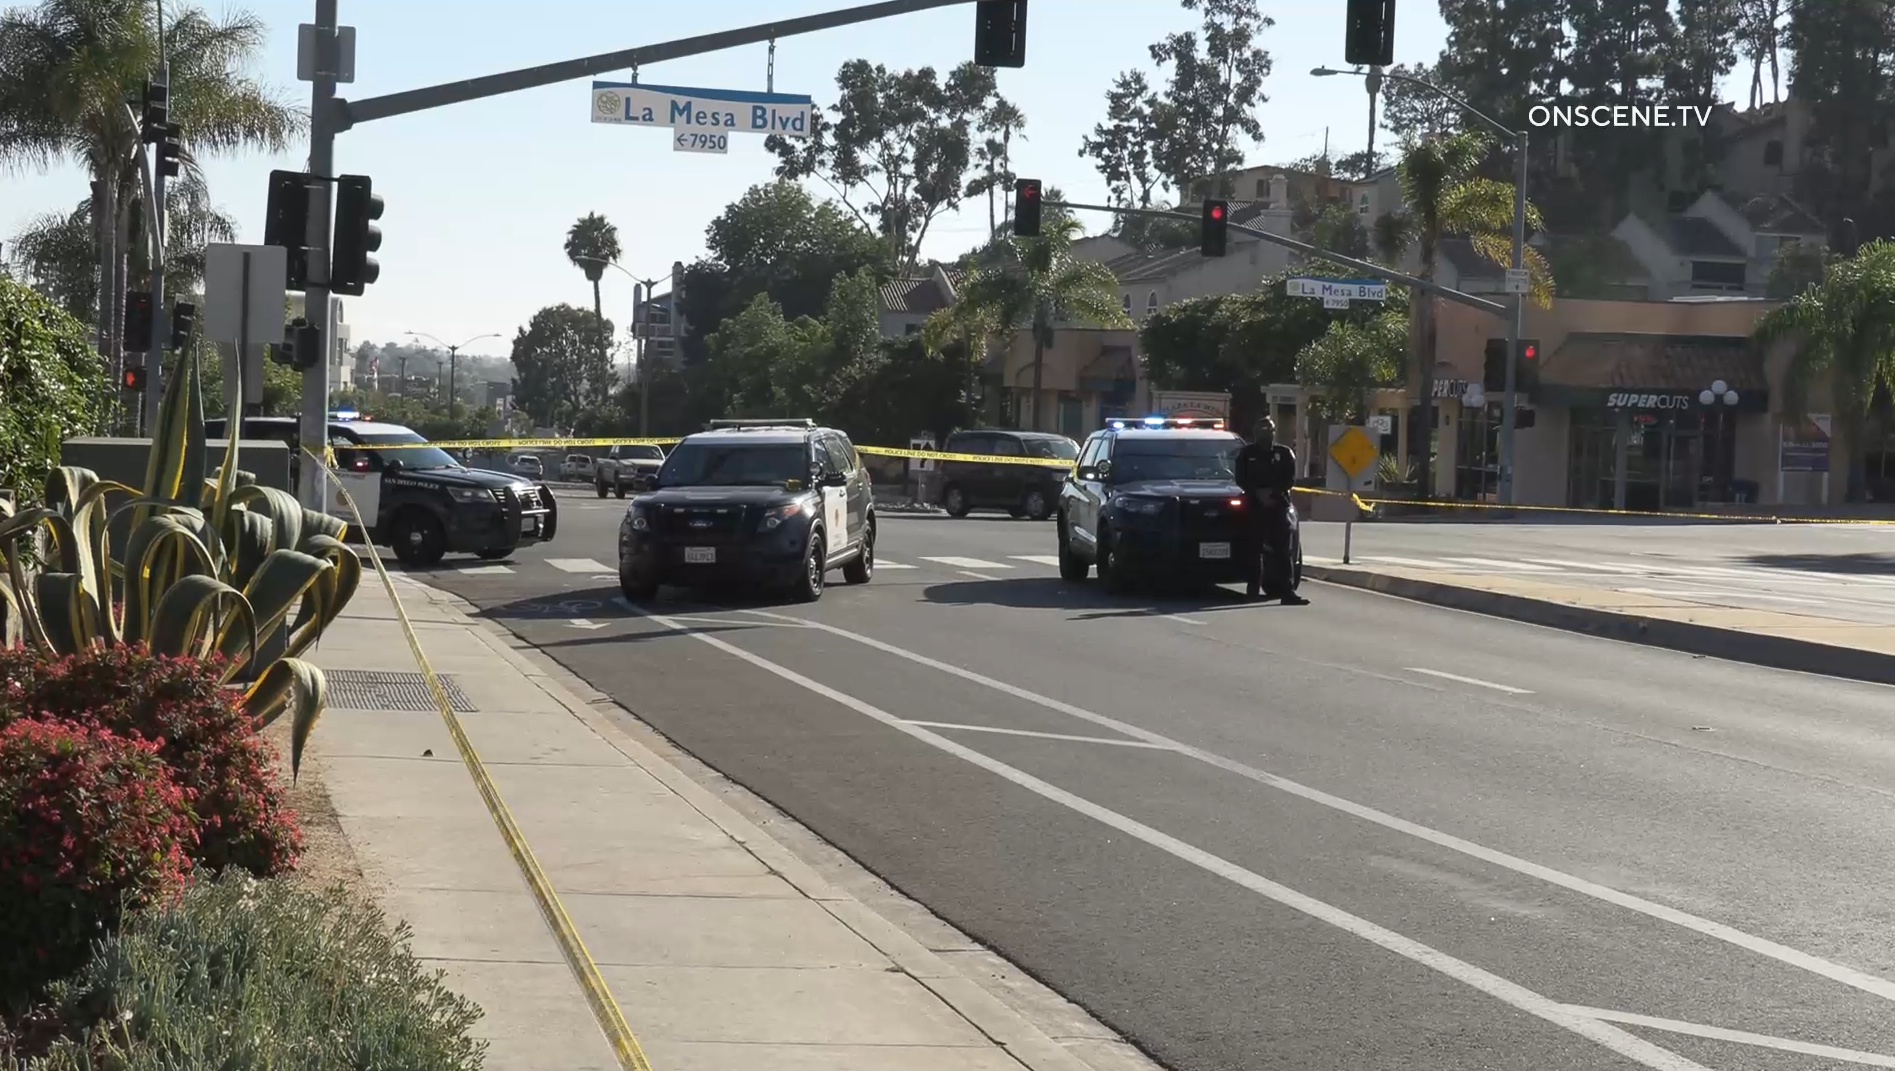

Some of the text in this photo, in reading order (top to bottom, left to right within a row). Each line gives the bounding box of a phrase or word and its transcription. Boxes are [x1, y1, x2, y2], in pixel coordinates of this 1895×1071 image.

[624, 97, 805, 132] La Mesa Blvd
[690, 133, 727, 150] 7950
[1301, 283, 1383, 298] La Mesa Blvd
[1331, 299, 1348, 307] 7950
[1607, 393, 1689, 409] SUPERCUTS
[418, 481, 439, 489] POLICE
